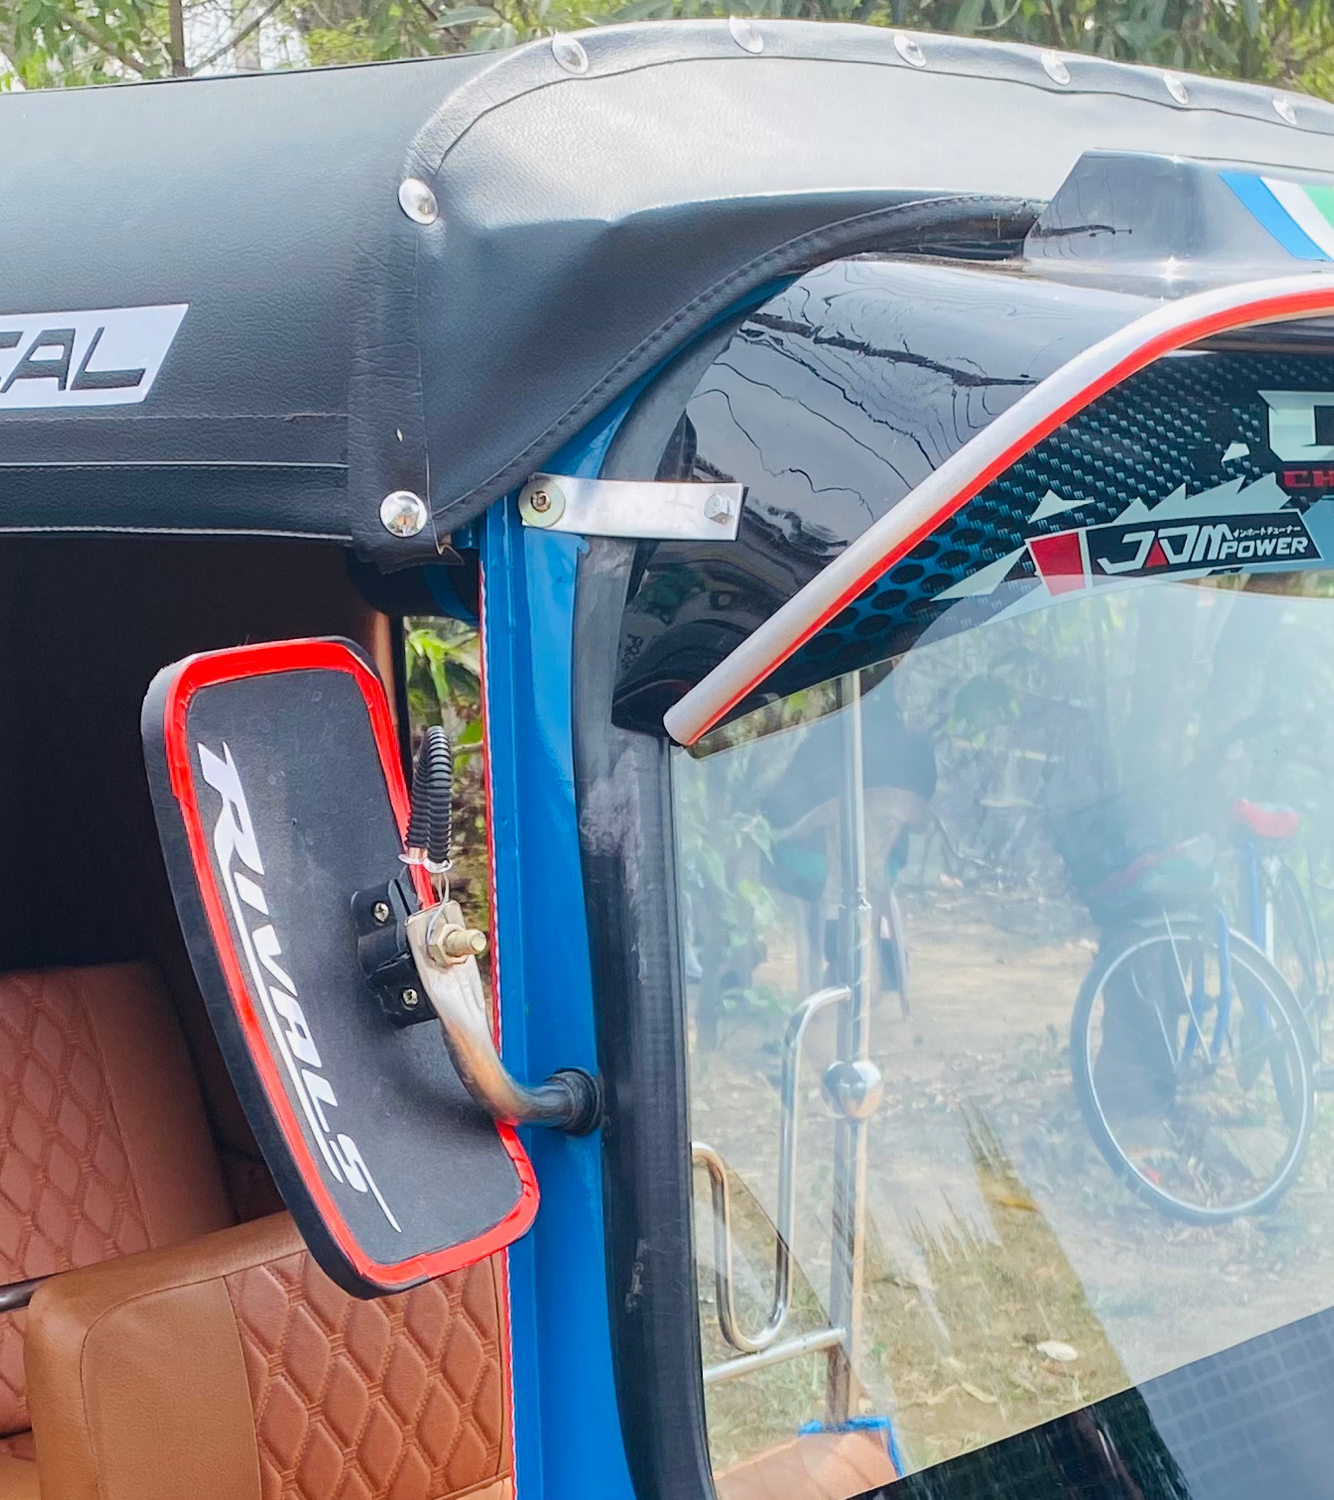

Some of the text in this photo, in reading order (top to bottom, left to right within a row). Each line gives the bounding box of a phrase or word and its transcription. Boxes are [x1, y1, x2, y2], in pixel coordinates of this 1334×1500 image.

[1096, 522, 1308, 575] JDM POWER
[196, 740, 402, 1234] RIVALS
